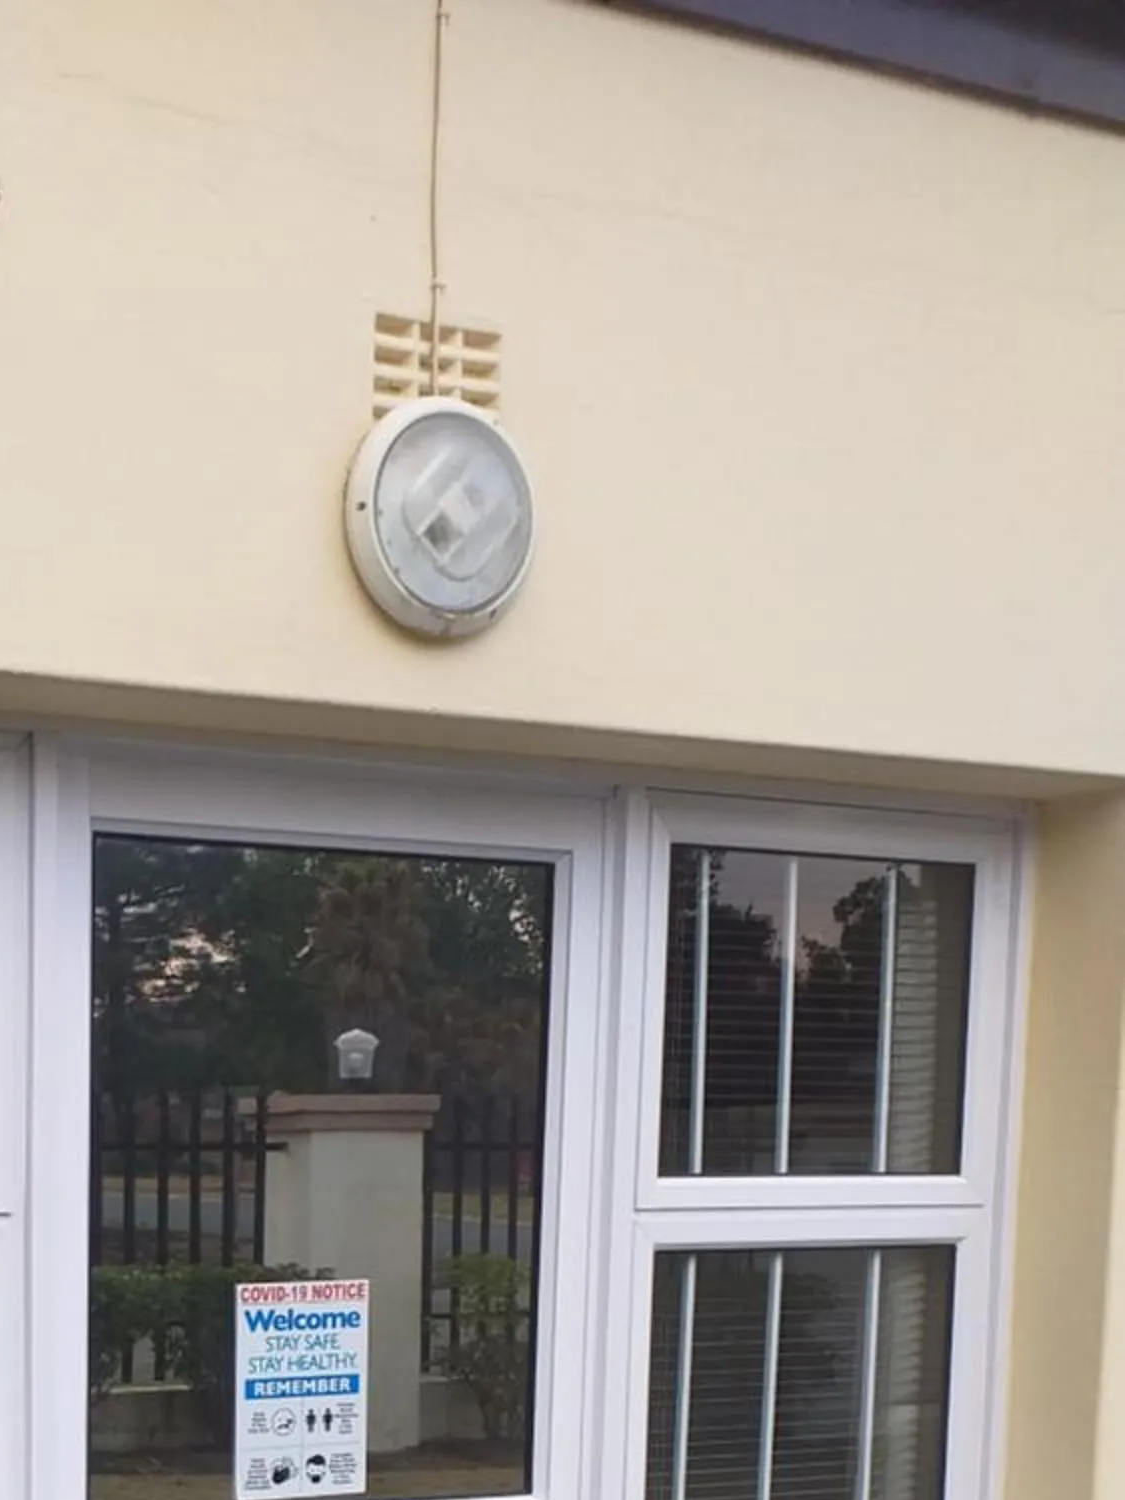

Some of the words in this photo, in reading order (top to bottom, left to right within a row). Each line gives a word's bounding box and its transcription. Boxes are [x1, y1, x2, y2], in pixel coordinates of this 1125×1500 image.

[241, 1286, 308, 1303] COVID-19
[312, 1283, 365, 1300] NOTICE
[244, 1308, 361, 1332] Welcome
[266, 1335, 300, 1353] STAY
[305, 1333, 340, 1350] SAFE
[248, 1356, 283, 1374] STAY
[254, 1378, 352, 1397] REMEMBER
